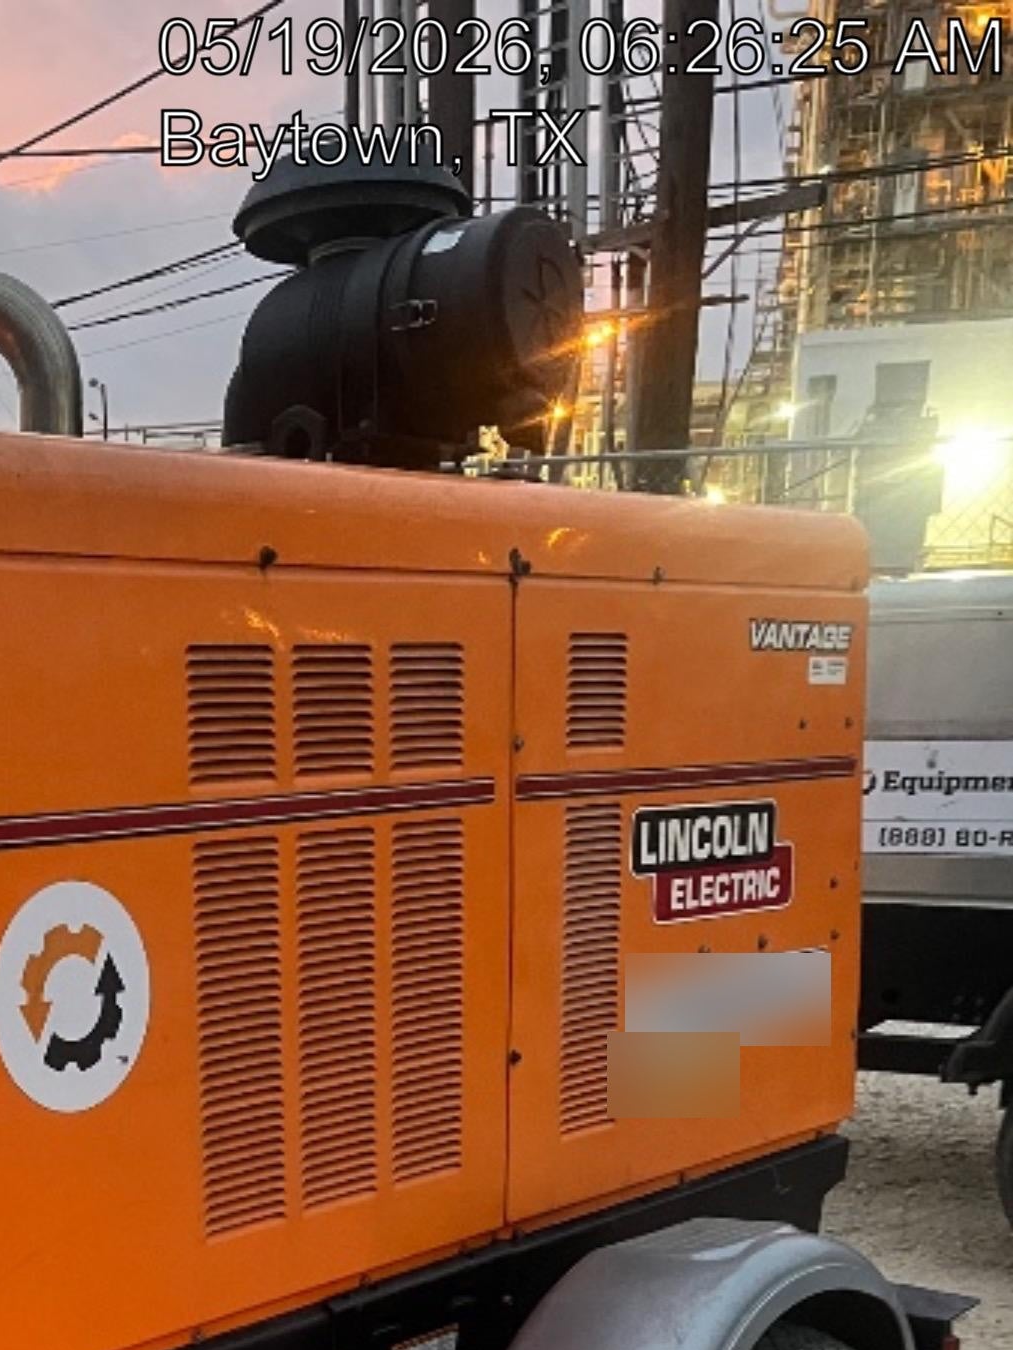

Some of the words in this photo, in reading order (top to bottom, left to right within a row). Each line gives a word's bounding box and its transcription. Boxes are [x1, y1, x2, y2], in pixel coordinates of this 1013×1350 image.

[749, 618, 851, 651] VANTAGE
[640, 811, 768, 866] LINCOLN
[670, 866, 781, 911] ELECTRIC
